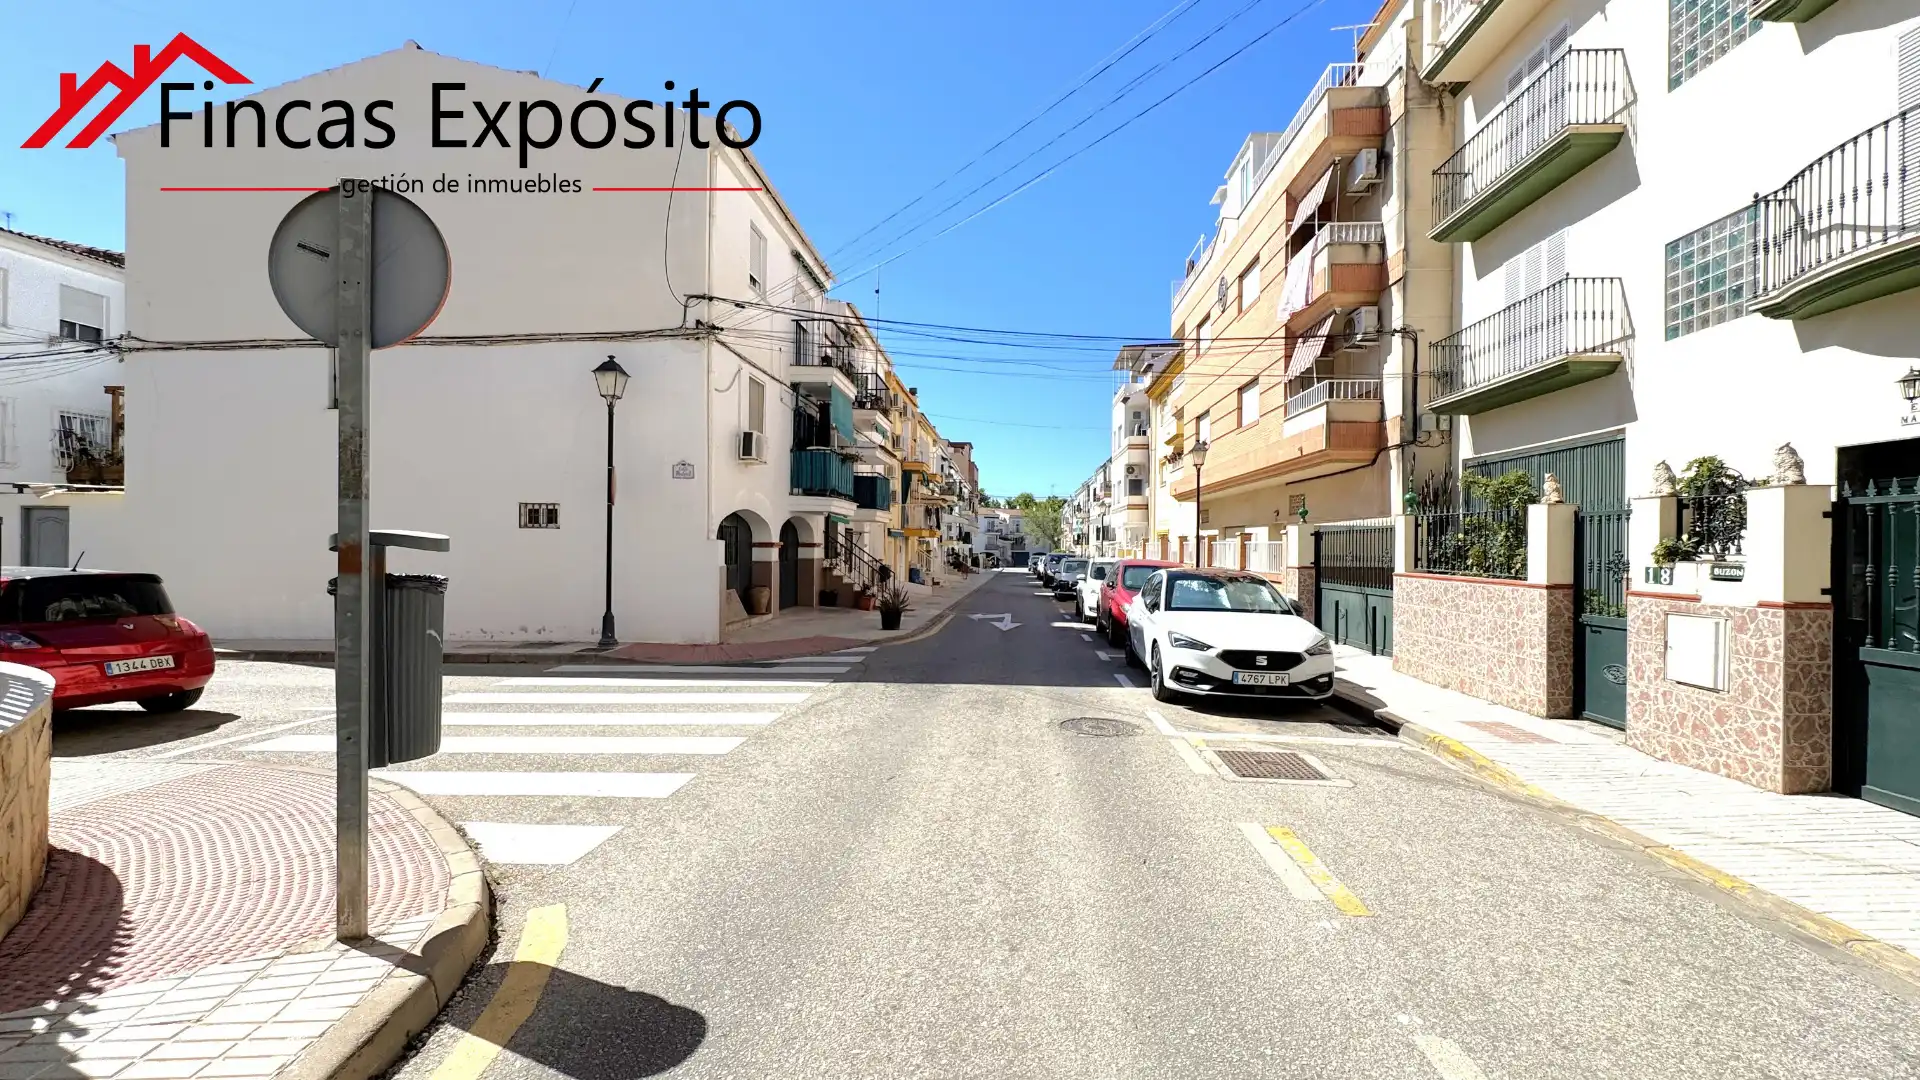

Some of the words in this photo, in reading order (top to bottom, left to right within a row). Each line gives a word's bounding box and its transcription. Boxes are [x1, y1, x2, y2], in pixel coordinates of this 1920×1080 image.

[1647, 567, 1671, 585] 18
[1713, 567, 1744, 577] BUZON
[115, 660, 147, 673] 1344
[150, 657, 171, 669] DBX
[1241, 674, 1266, 684] 4767
[1268, 675, 1287, 685] LPK
